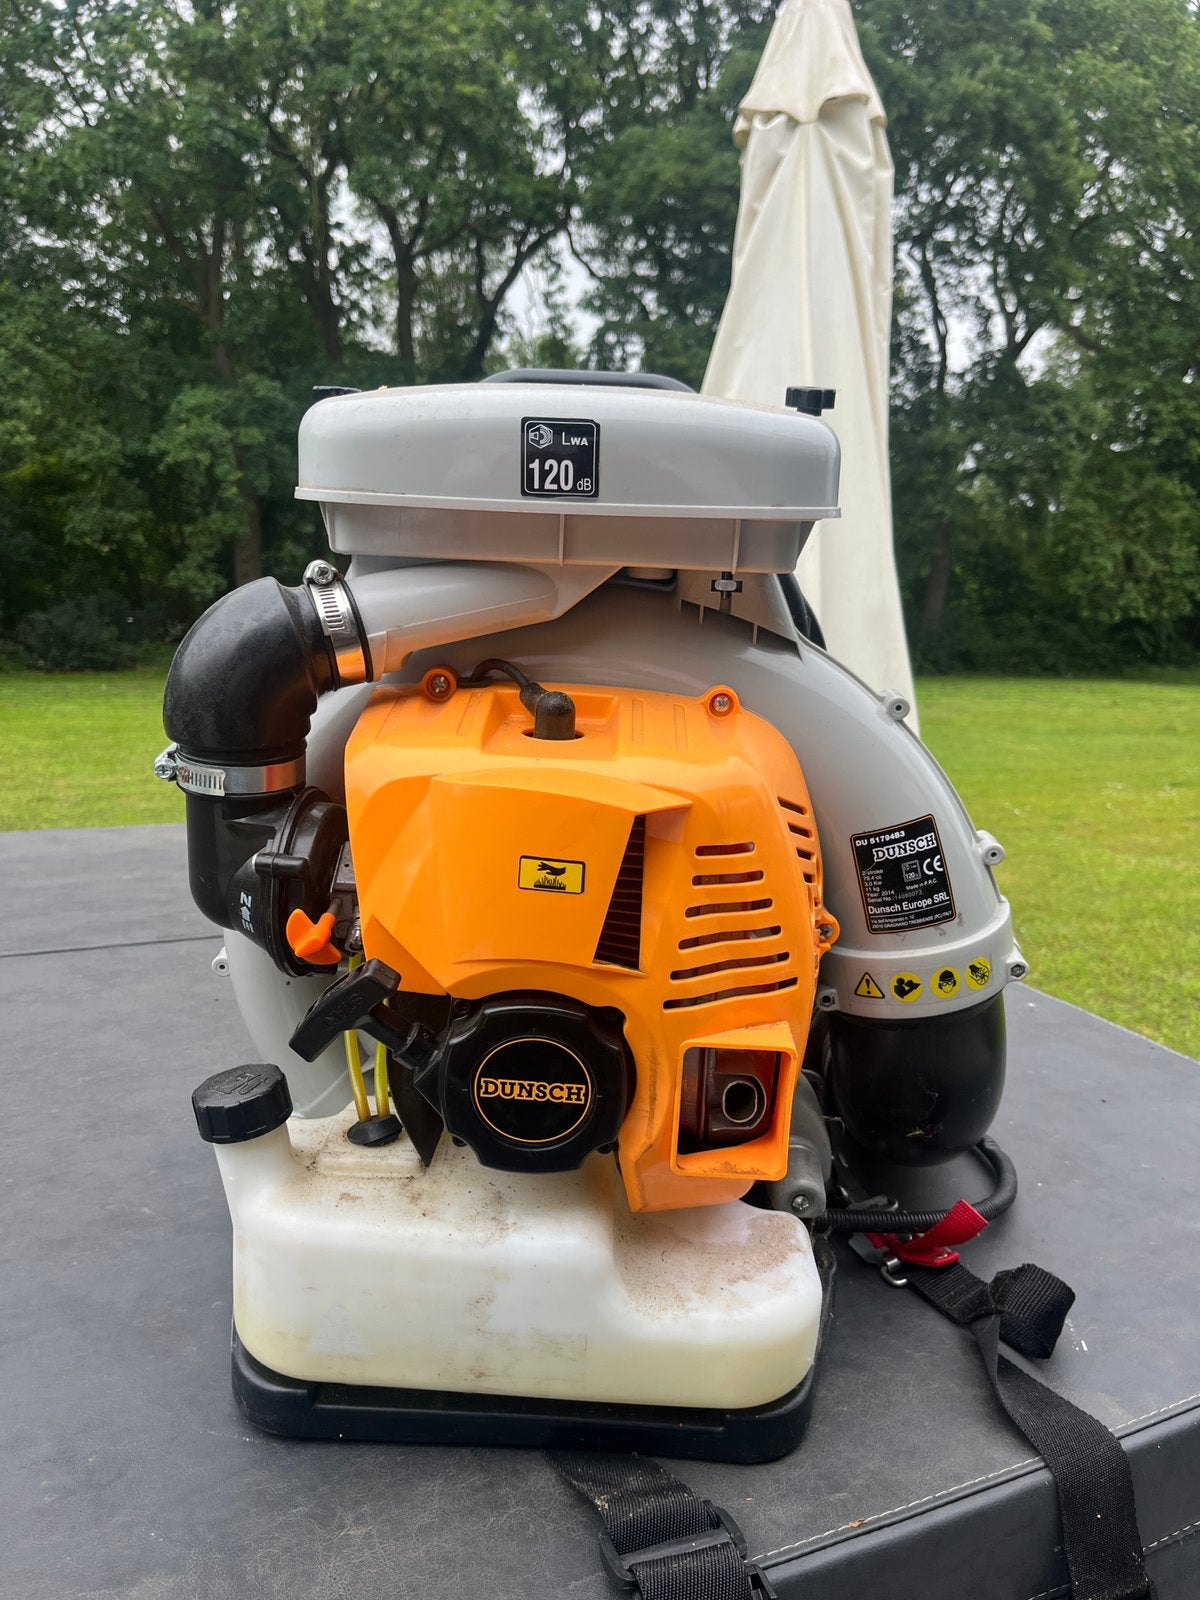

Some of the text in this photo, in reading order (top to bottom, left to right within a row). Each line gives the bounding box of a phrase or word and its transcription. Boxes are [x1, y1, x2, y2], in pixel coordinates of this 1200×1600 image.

[529, 459, 592, 490] 120 dB
[855, 839, 868, 847] DU
[873, 832, 937, 862] DUNSCH
[923, 855, 944, 875] CE
[868, 892, 950, 914] Dunsch Europe SRL
[480, 1078, 585, 1104] DUNSCH
